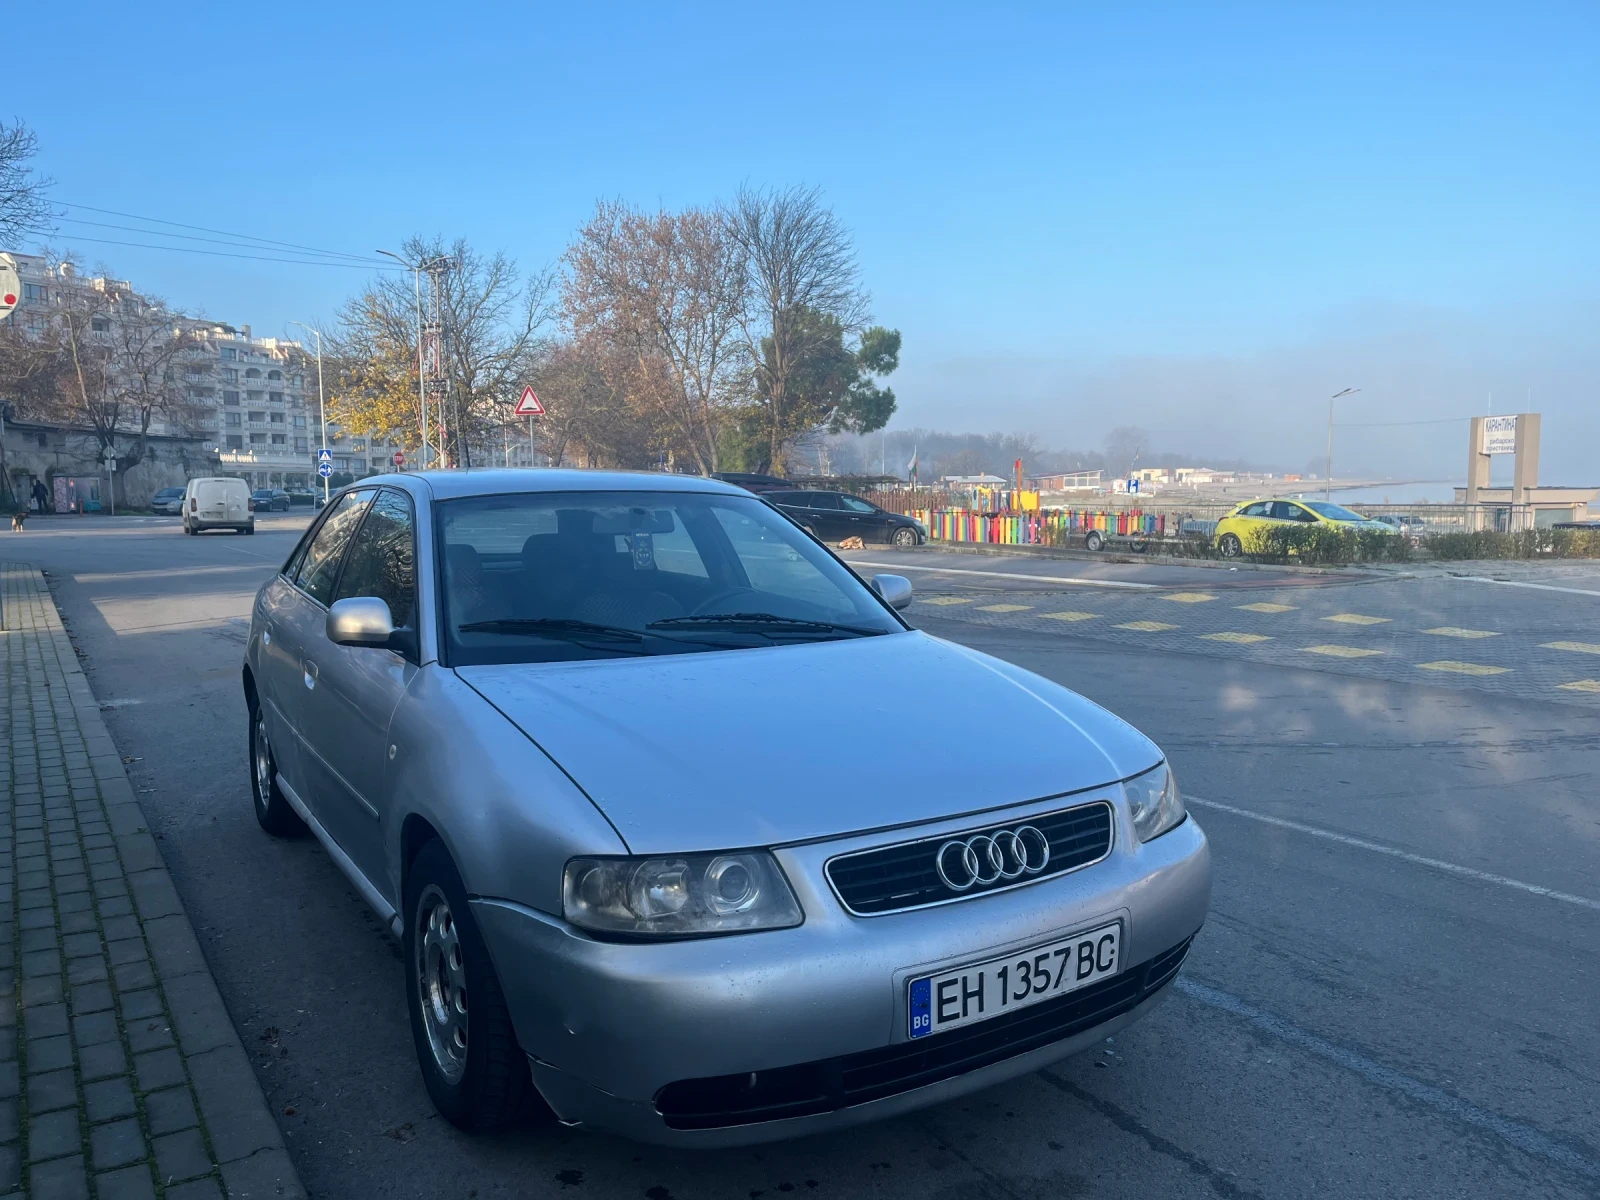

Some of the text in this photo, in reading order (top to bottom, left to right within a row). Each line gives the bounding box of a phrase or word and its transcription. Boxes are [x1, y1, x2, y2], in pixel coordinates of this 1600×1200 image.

[937, 933, 1115, 1024] EH 1357 BC
[913, 1013, 930, 1030] BG
